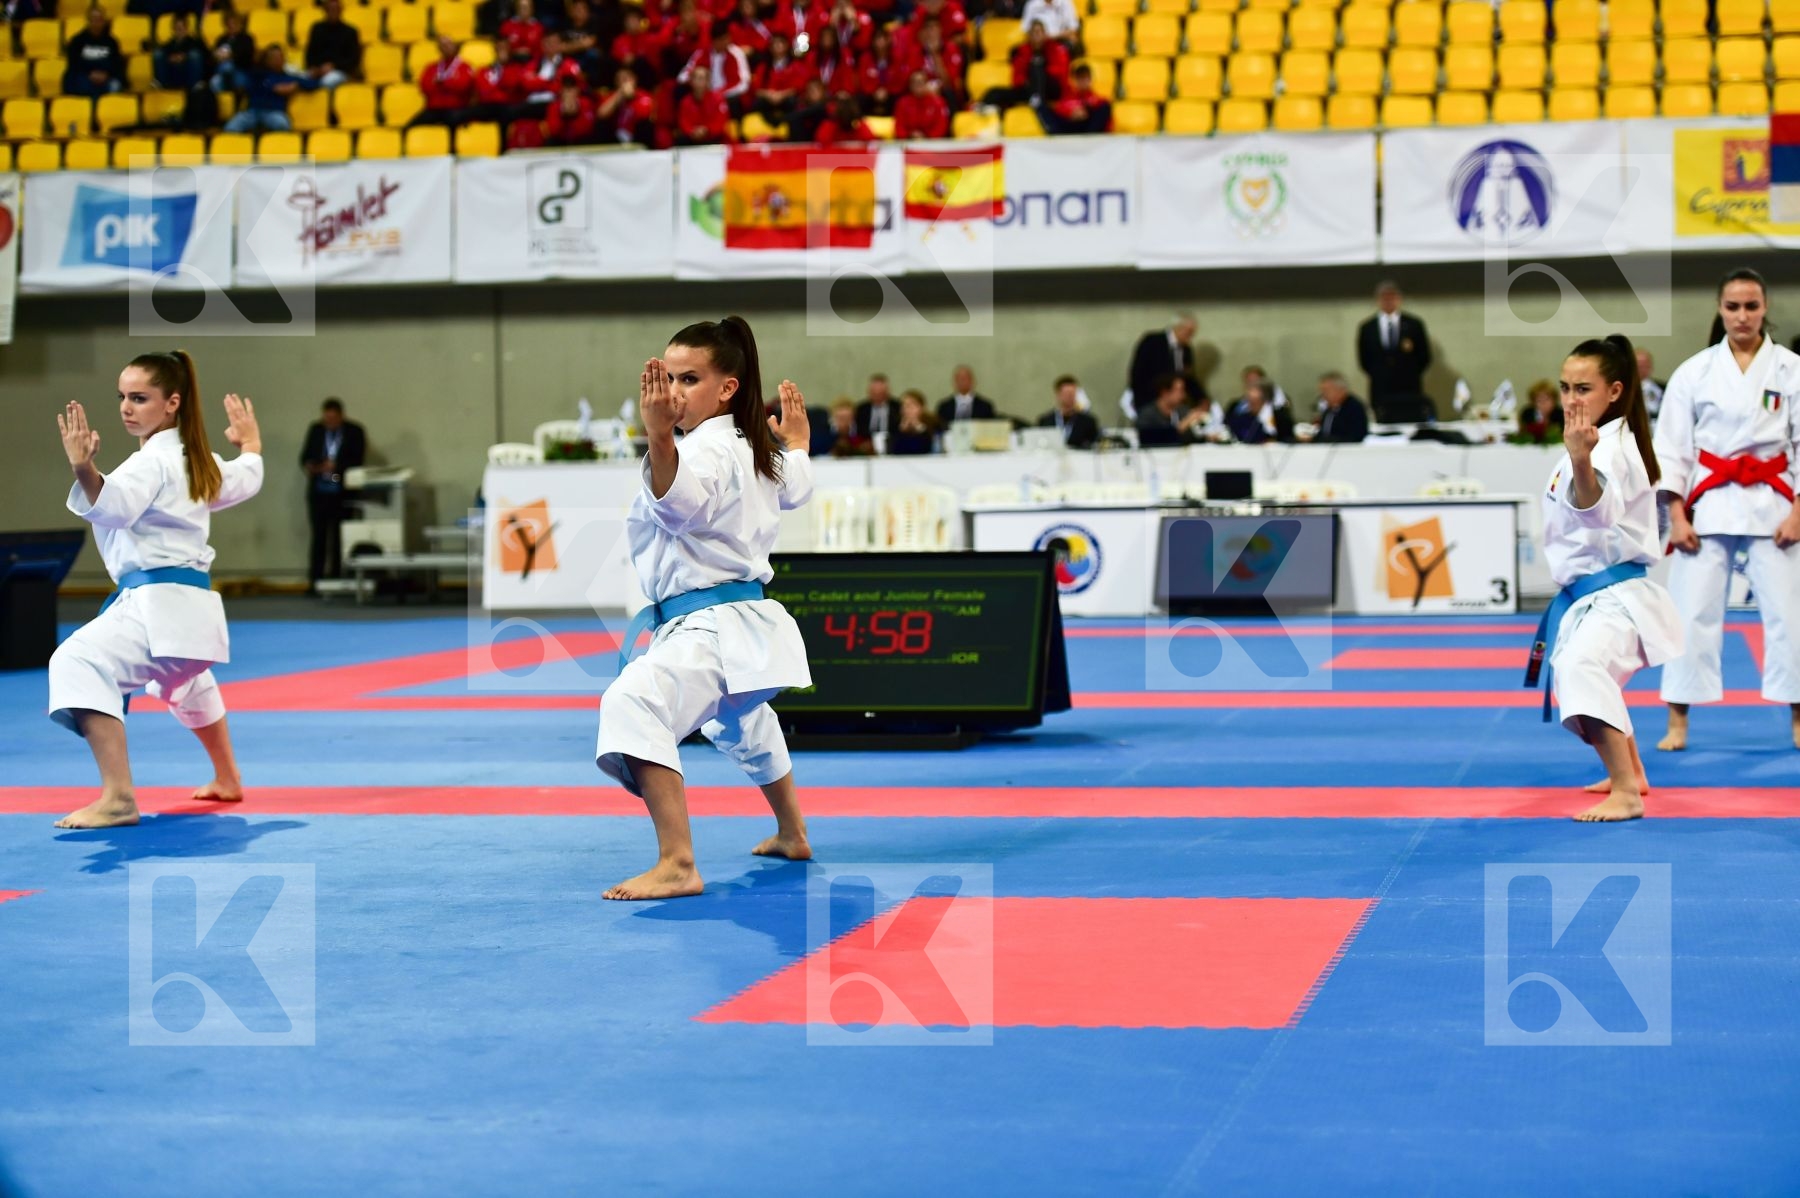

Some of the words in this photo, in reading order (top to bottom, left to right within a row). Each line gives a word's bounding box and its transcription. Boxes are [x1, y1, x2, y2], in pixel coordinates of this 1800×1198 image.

[808, 590, 850, 601] Cadet
[853, 590, 880, 601] and
[883, 590, 929, 602] Junior
[934, 589, 986, 601] Female
[1490, 578, 1509, 604] 3
[824, 610, 934, 655] 4:58
